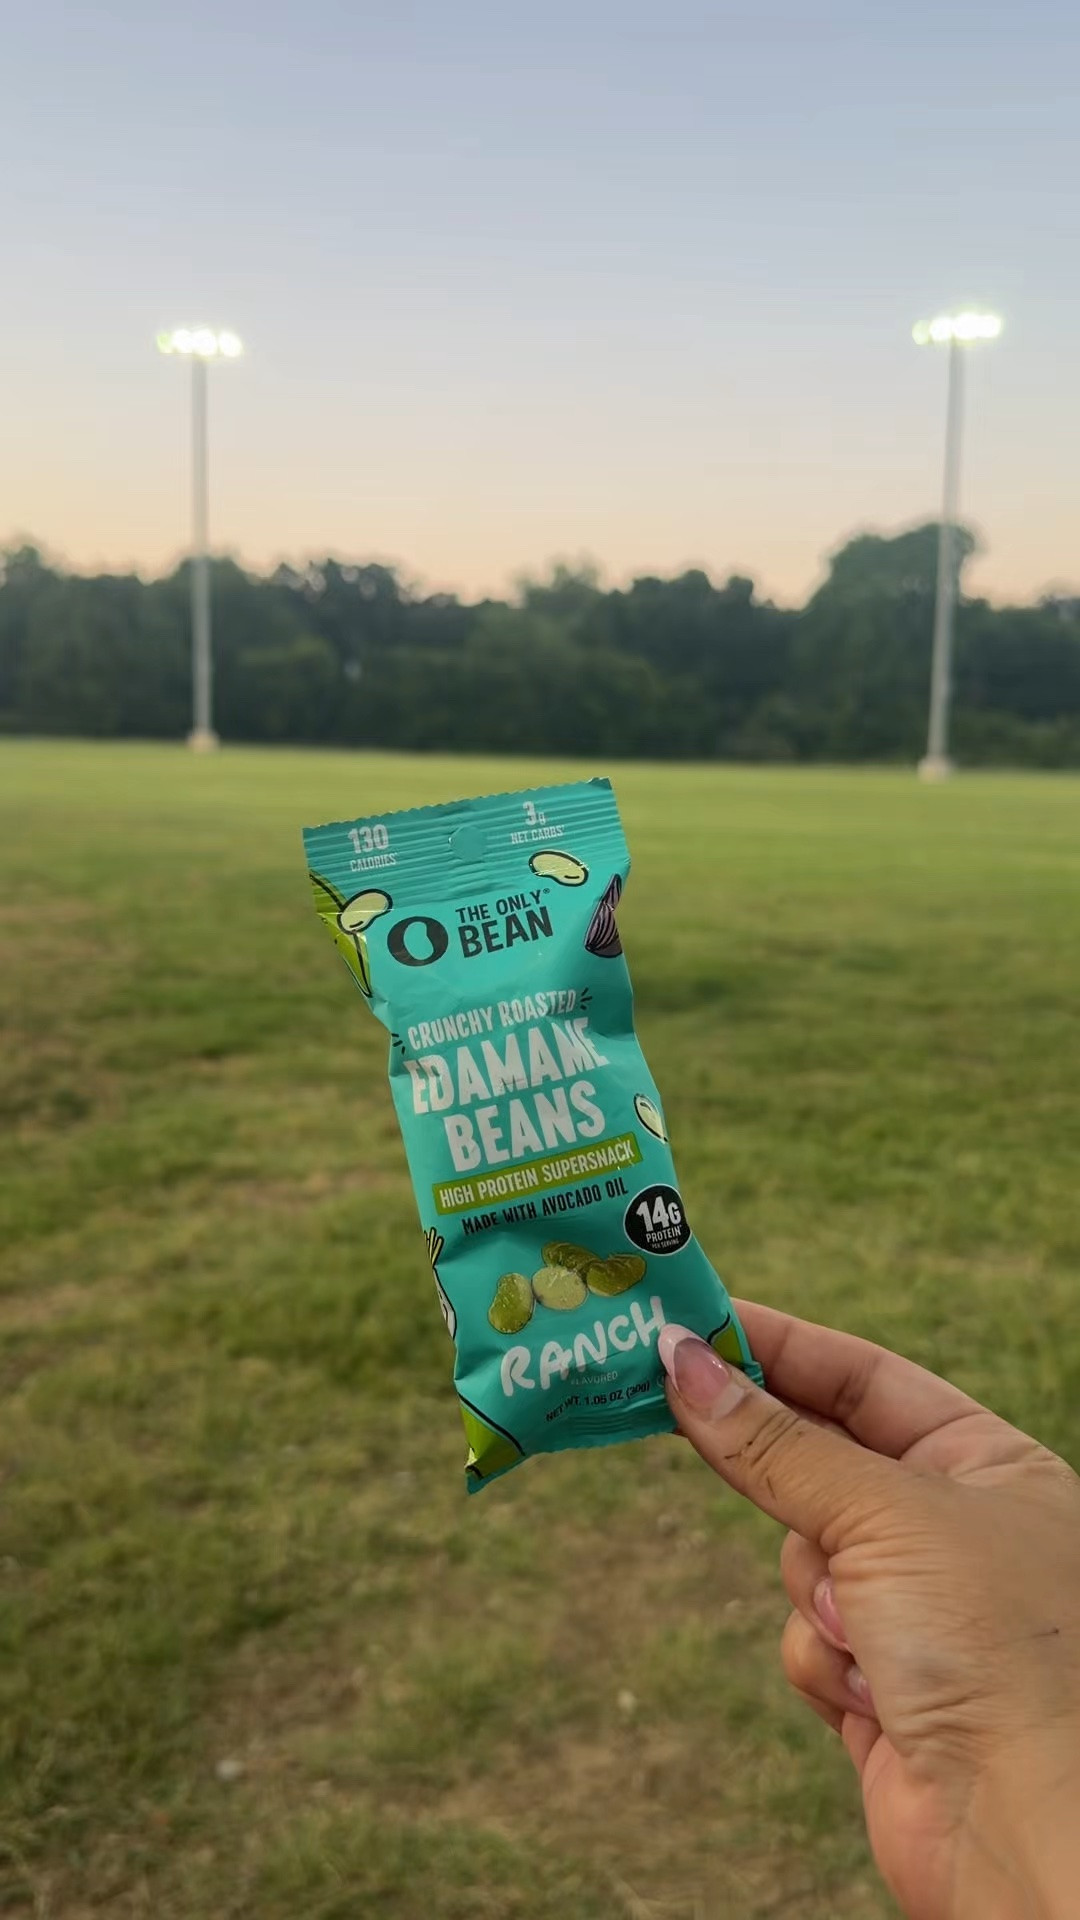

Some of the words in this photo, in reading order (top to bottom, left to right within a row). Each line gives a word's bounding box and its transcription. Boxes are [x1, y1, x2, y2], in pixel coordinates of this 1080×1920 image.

[347, 824, 389, 854] 130
[510, 829, 531, 845] NET
[455, 903, 490, 924] THE
[458, 906, 553, 958] BEAN
[408, 1006, 493, 1051] CRUNCHY
[497, 990, 577, 1028] ROASTED
[403, 1017, 610, 1115] EDAMAME
[443, 1080, 606, 1172] BEANS
[439, 1185, 475, 1209] HIGH
[477, 1168, 539, 1199] PROTEIN
[543, 1140, 635, 1183] SUPERSNACK
[462, 1214, 501, 1236] MADE
[502, 1202, 537, 1223] WITH
[543, 1184, 603, 1217] AVOCADO
[605, 1177, 628, 1198] OIL
[636, 1196, 682, 1232] 14G
[501, 1296, 666, 1396] RANCH
[545, 1402, 565, 1422] NET
[585, 1395, 607, 1406] 1.05
[610, 1389, 624, 1402] OZ
